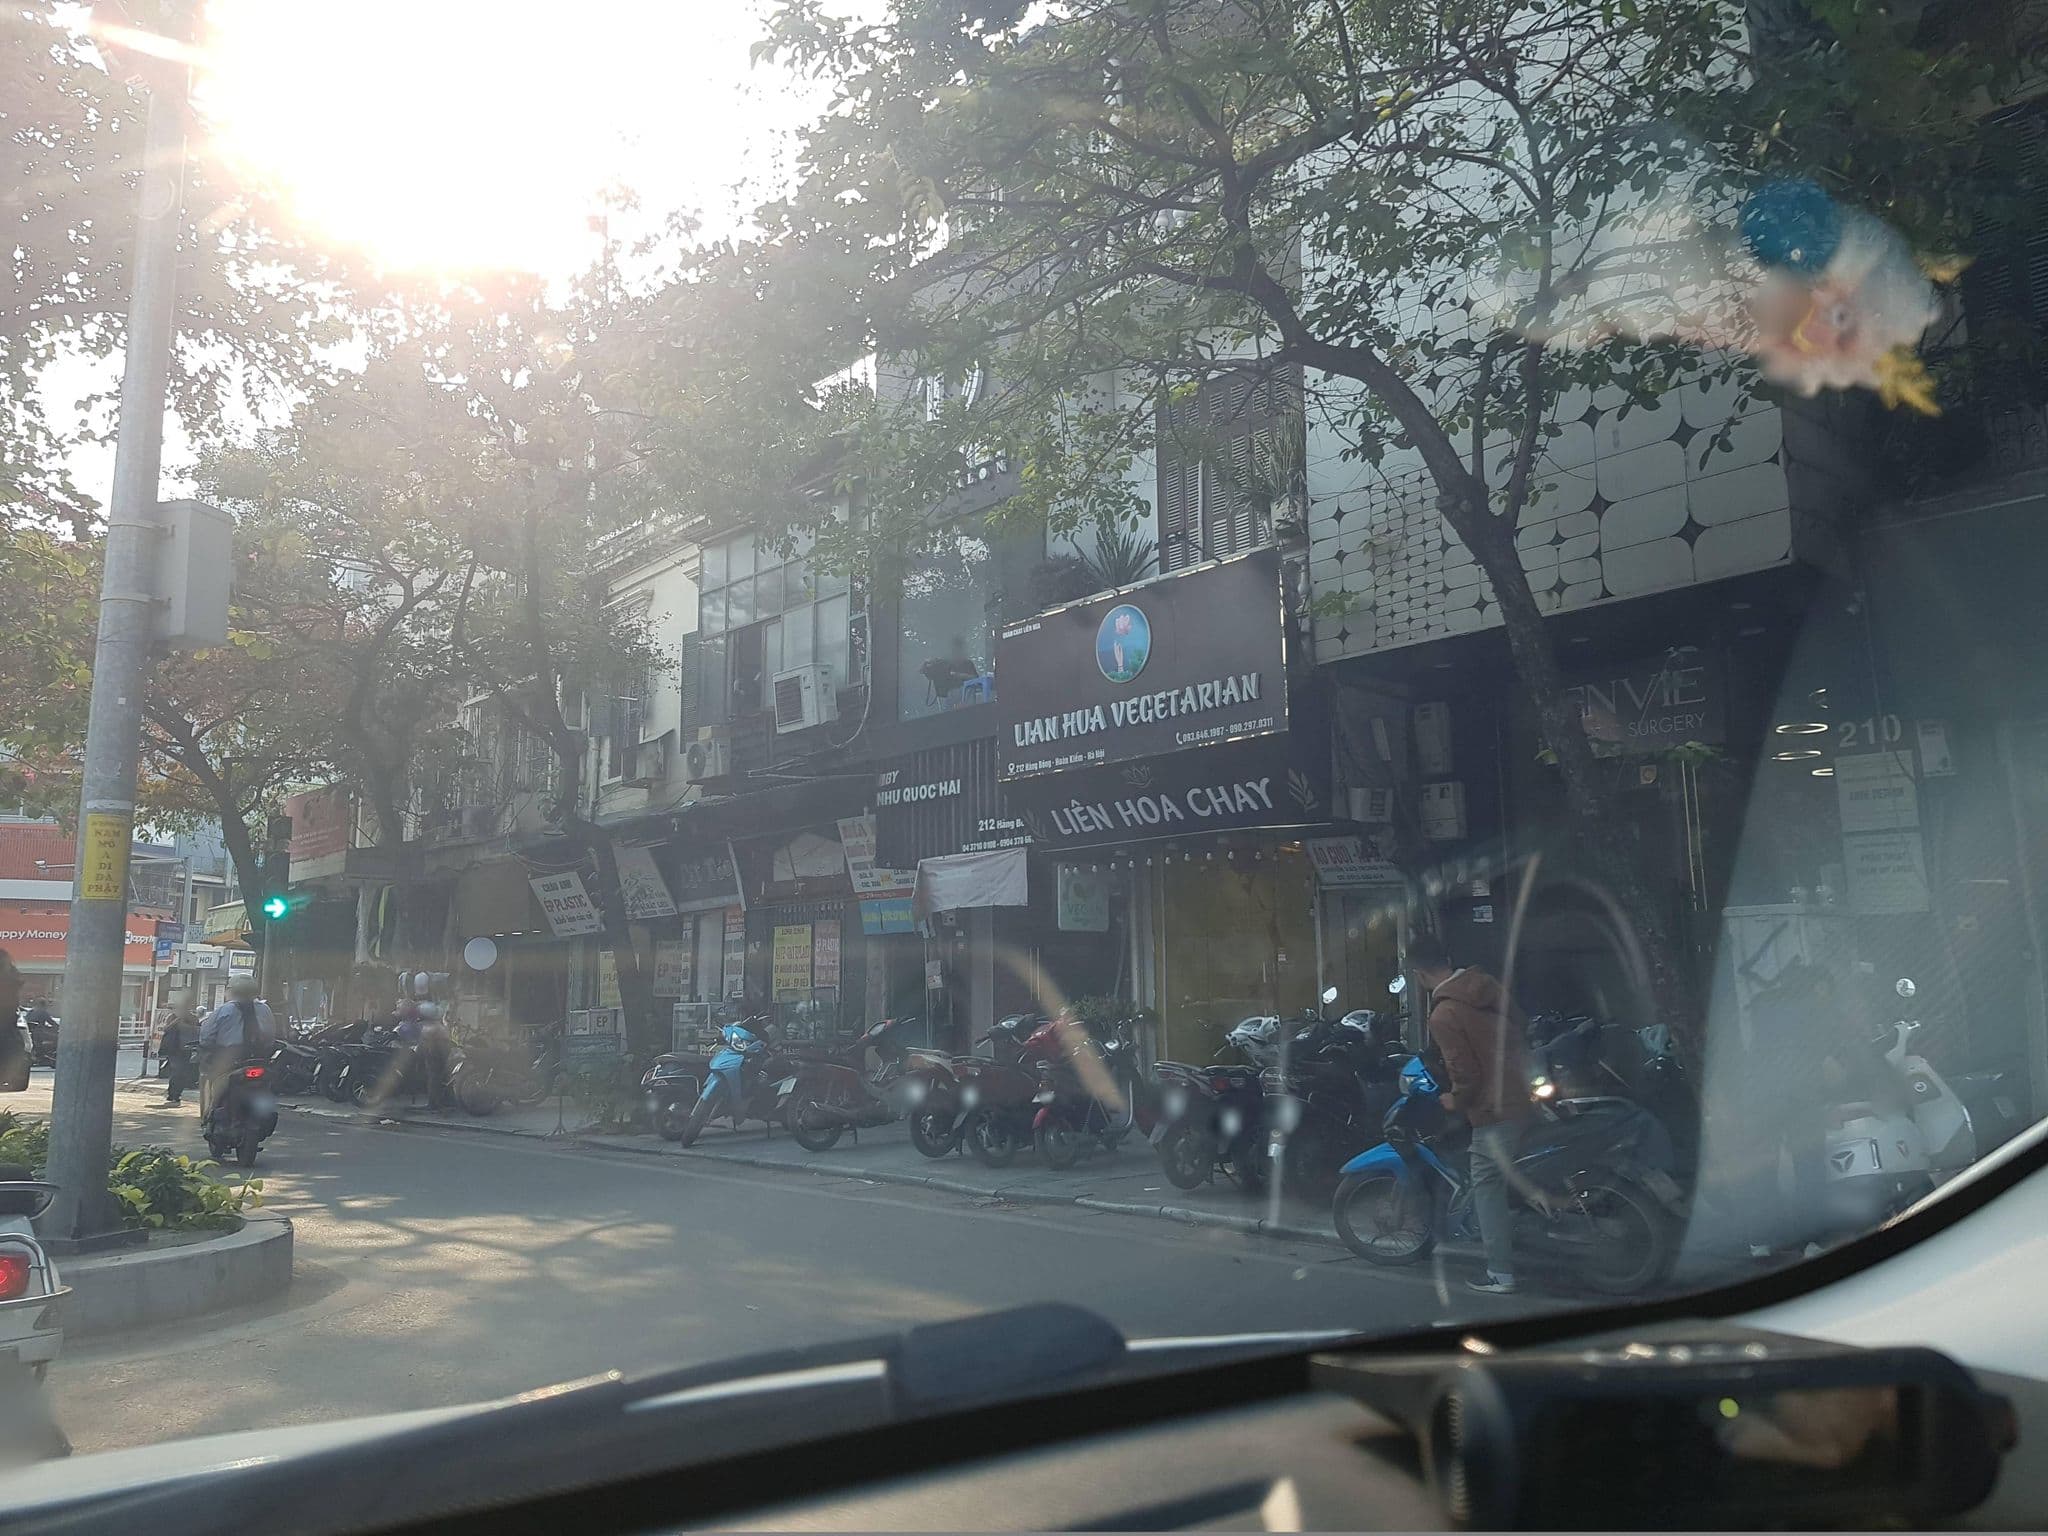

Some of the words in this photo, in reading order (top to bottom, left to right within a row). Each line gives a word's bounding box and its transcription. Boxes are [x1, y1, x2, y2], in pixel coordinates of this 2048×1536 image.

[1014, 715, 1060, 748] LIAN
[1062, 704, 1107, 739] HUA
[1110, 671, 1260, 728] VEGETARIAN
[1627, 711, 1705, 737] SURGERY
[1839, 714, 1902, 748] 210
[1051, 799, 1115, 835] LIÊN
[1114, 794, 1184, 827] HOA
[1186, 777, 1273, 817] CHAY
[978, 818, 996, 831] 212
[996, 818, 1015, 830] Hàng
[26, 929, 67, 941] Money
